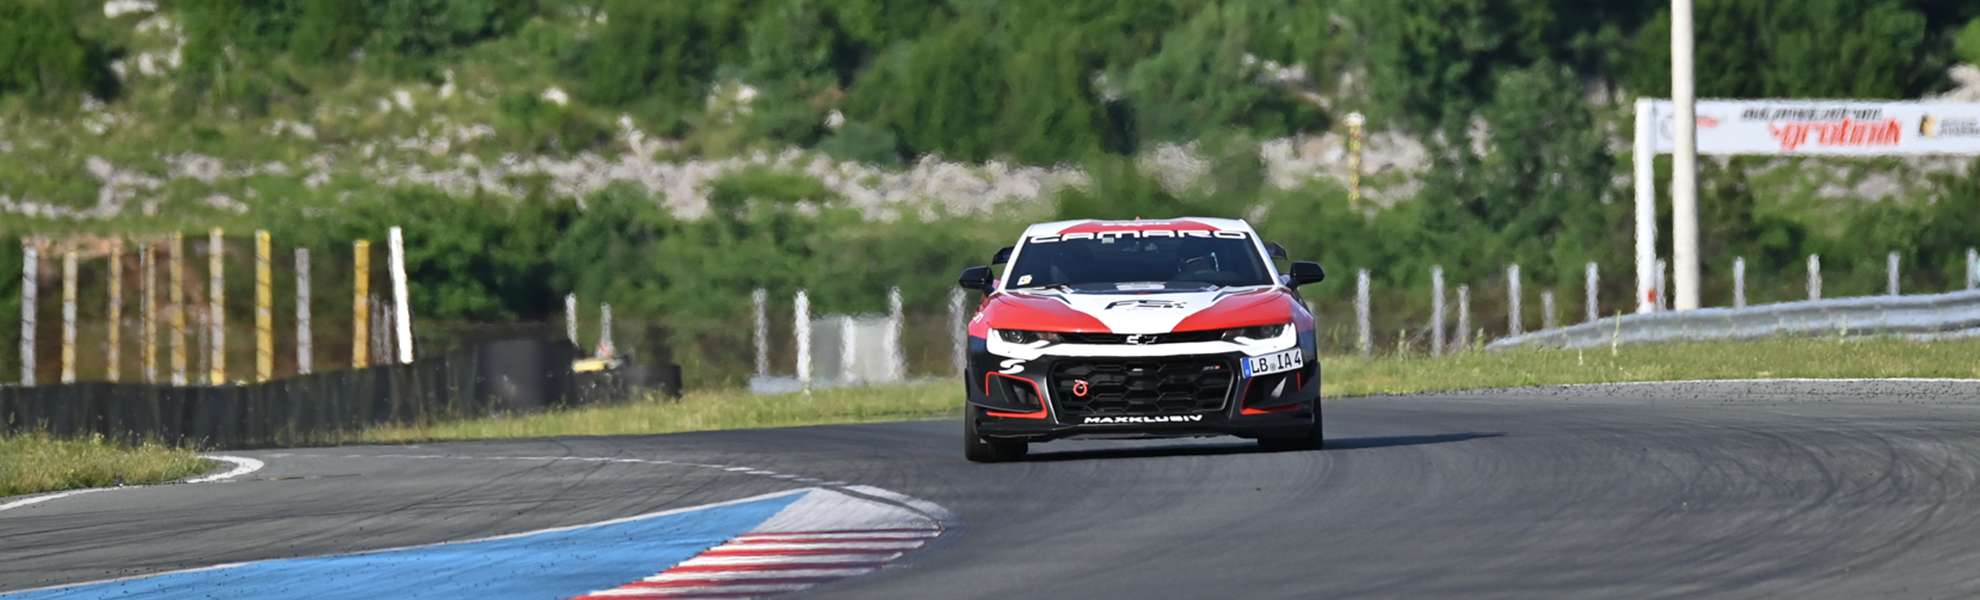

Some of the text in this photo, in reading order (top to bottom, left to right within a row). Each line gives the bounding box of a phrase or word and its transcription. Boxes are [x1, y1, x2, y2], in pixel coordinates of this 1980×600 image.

[1030, 229, 1247, 244] CAMARO
[1250, 350, 1302, 374] LB IA 4
